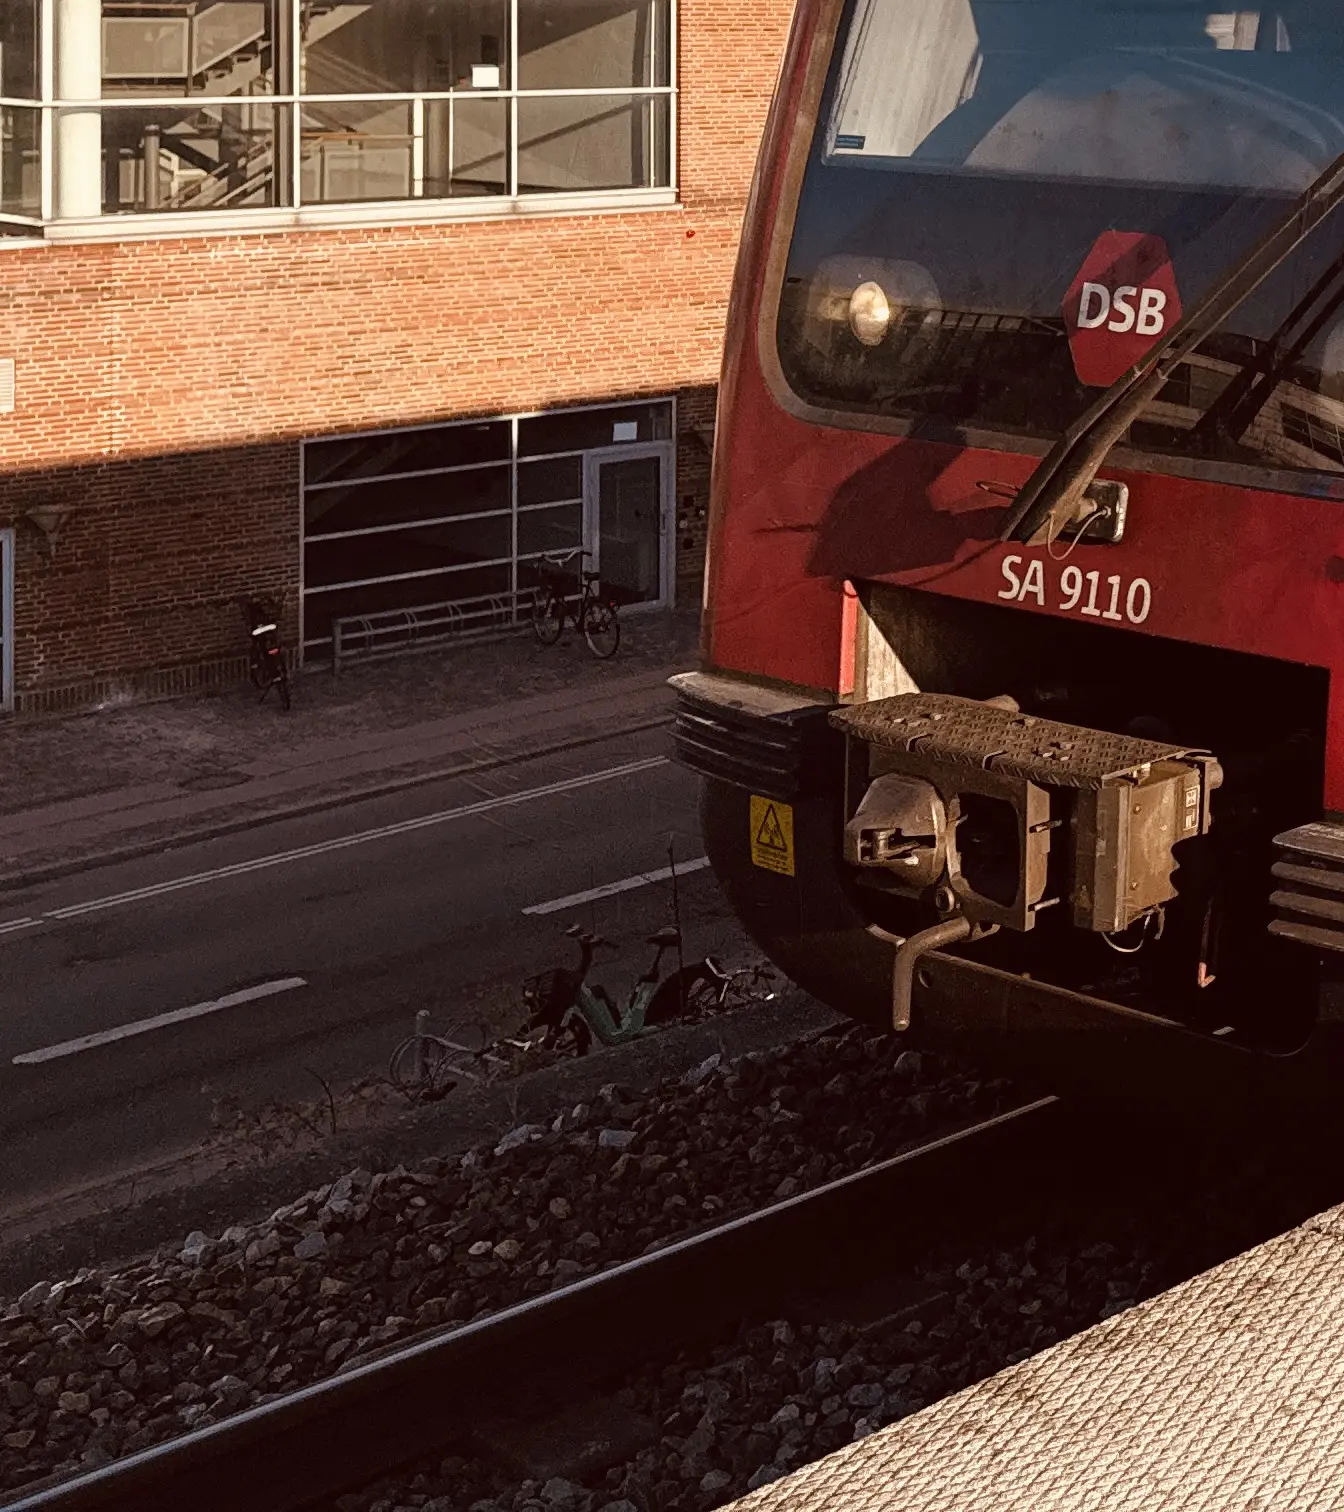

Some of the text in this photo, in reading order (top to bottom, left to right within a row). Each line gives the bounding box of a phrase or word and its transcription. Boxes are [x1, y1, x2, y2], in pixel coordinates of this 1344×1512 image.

[1077, 281, 1167, 336] DSB
[998, 554, 1151, 625] SA 9110
